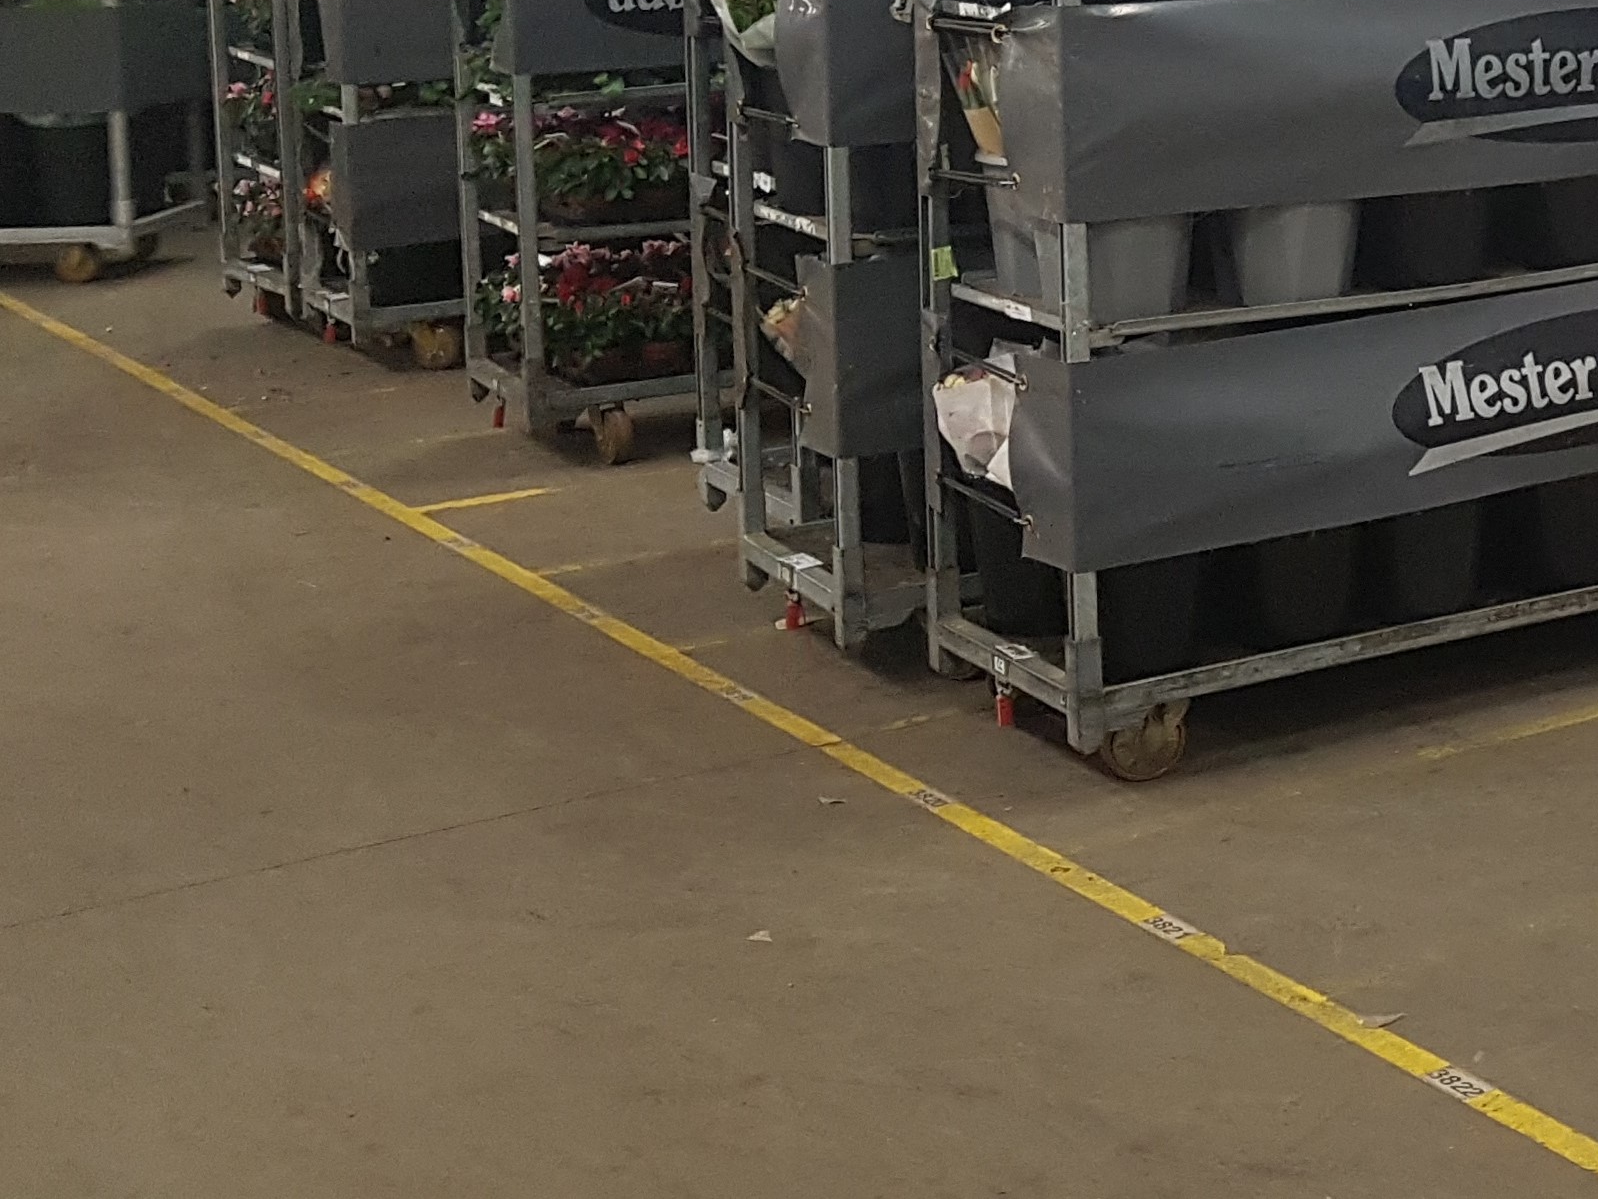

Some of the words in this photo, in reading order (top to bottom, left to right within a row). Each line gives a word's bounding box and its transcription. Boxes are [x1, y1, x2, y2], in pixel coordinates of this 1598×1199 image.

[1419, 352, 1597, 427] Mester
[1143, 917, 1192, 939] 3821
[1428, 1069, 1485, 1098] 3822
